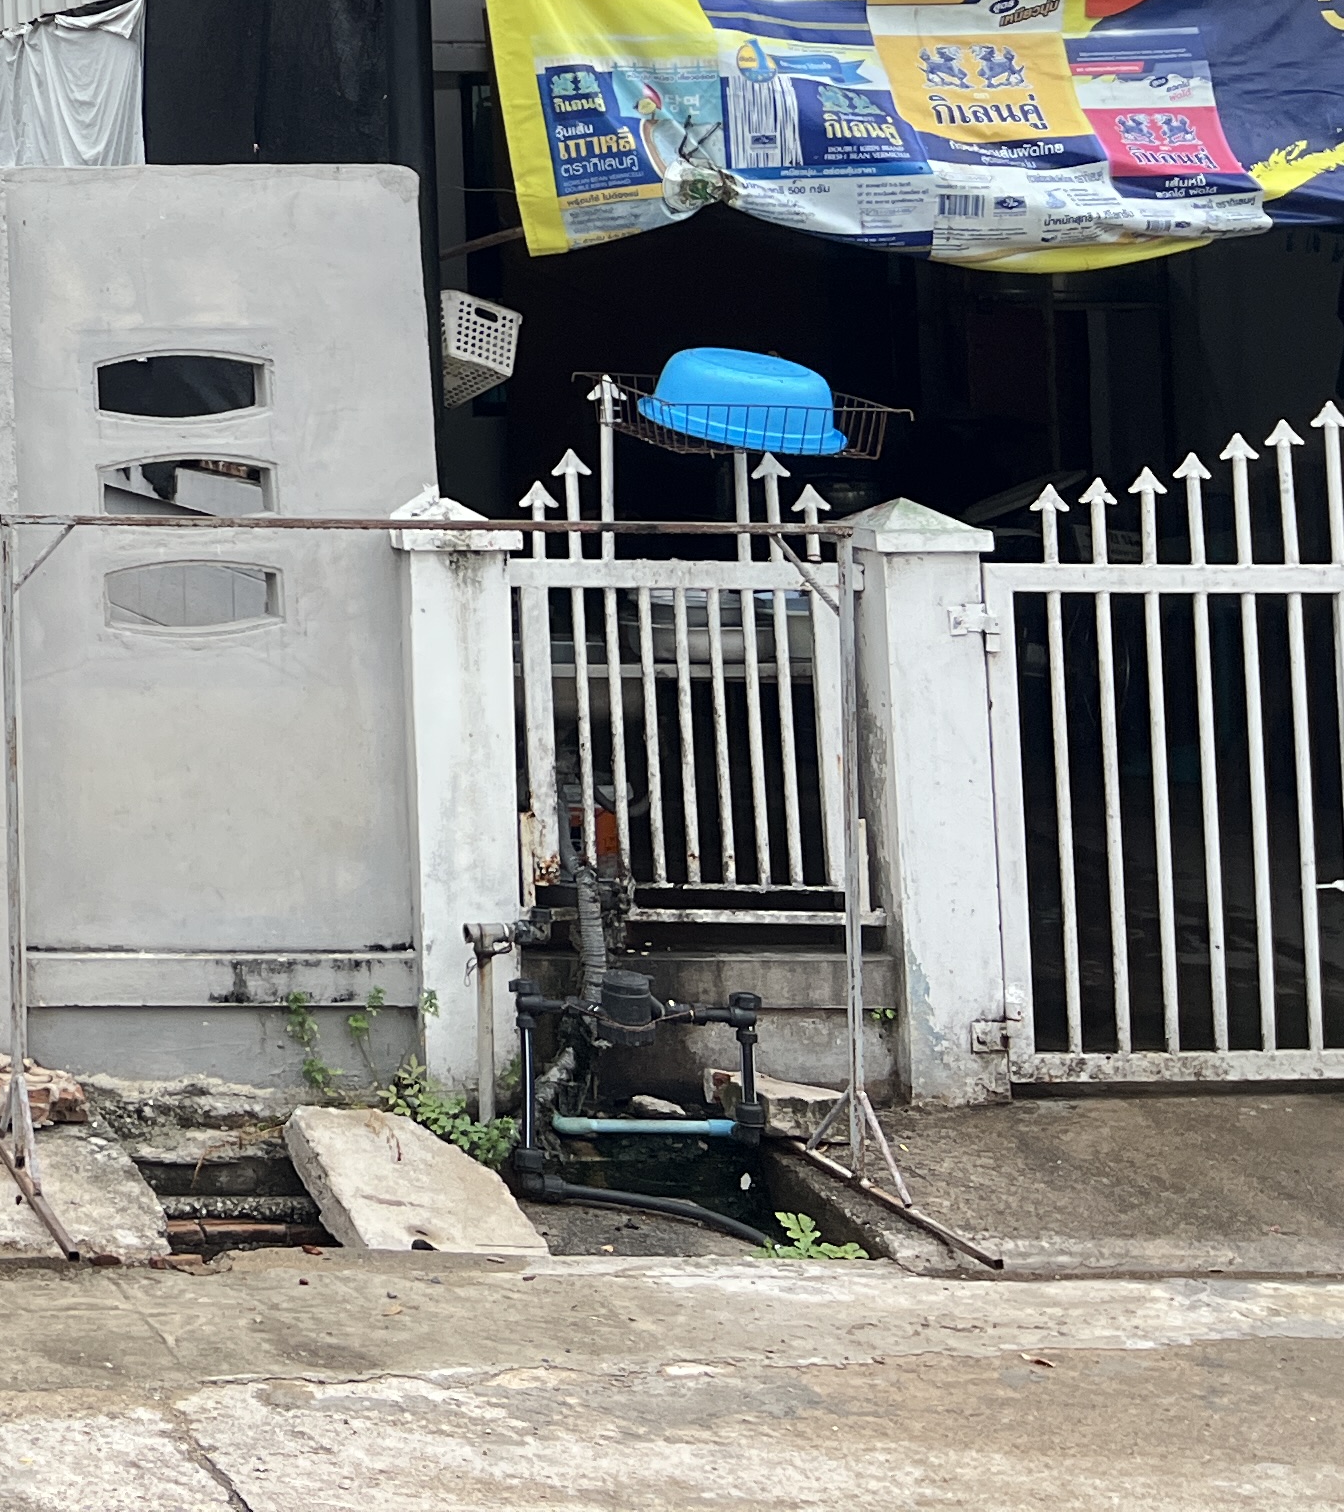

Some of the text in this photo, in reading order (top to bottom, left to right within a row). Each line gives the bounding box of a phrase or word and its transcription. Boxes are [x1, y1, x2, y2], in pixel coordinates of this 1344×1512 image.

[928, 94, 1048, 131] กิเลนคู่
[558, 126, 636, 160] เกาหลี
[823, 112, 903, 146] กิเลนคู่
[561, 151, 639, 177] ตรากิเลนคู่
[1128, 144, 1220, 169] กิเลนคู่
[787, 186, 806, 194] 500
